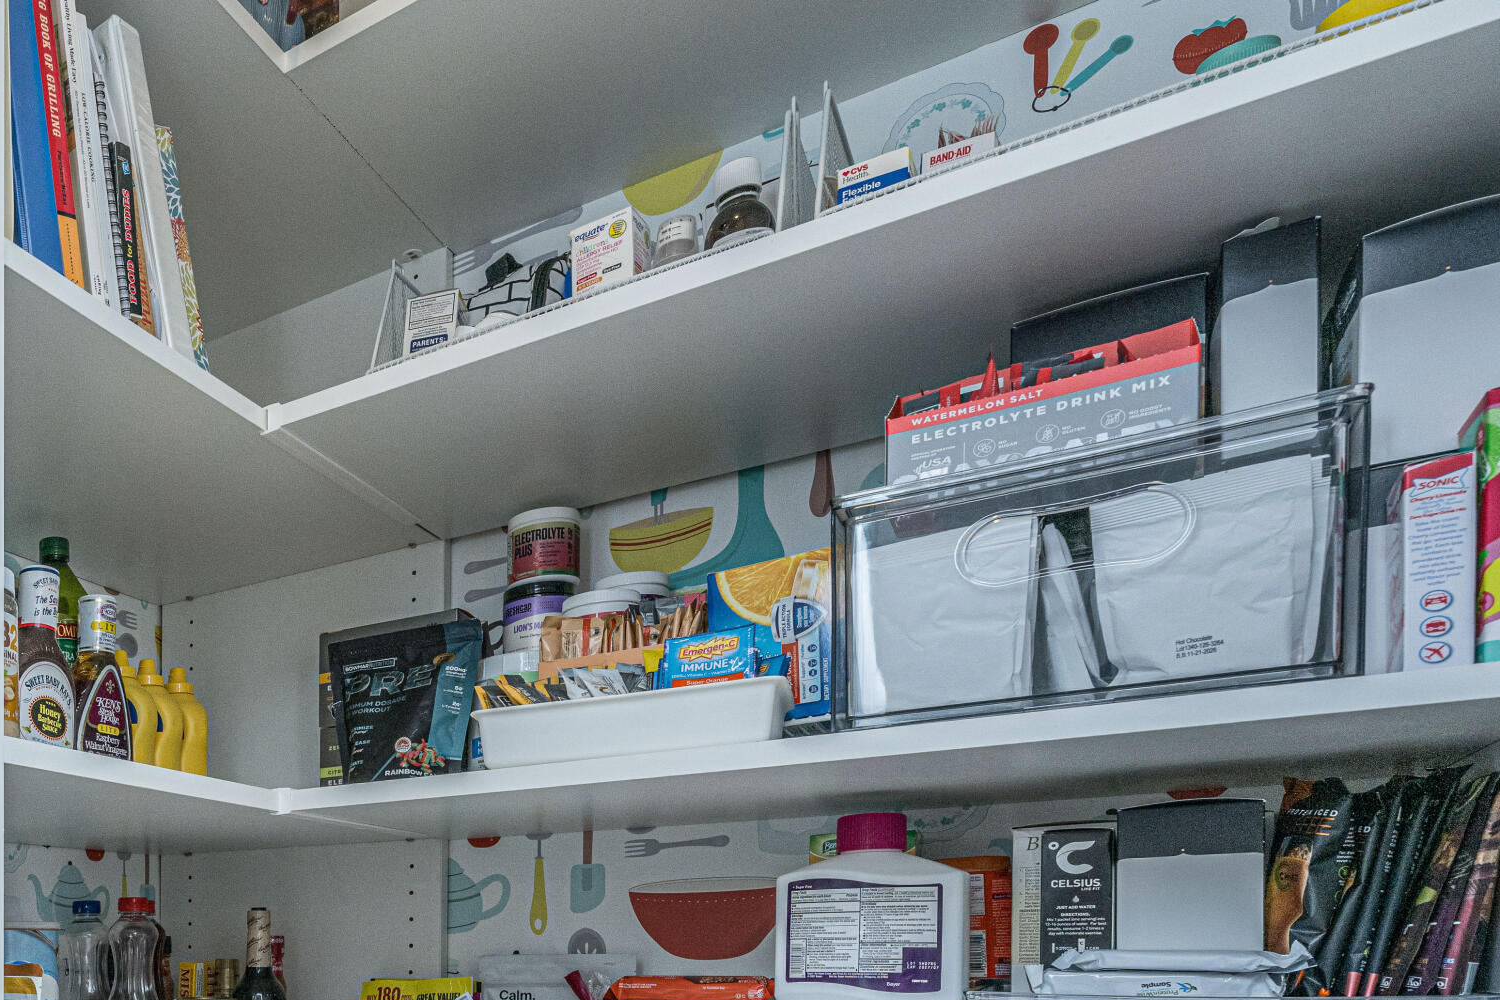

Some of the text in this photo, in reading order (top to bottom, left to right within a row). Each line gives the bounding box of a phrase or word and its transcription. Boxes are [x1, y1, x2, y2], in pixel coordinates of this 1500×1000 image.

[40, 14, 61, 138] BOOK GRILLING
[930, 145, 972, 165] BAND-AID
[850, 164, 869, 175] CVS
[842, 181, 882, 198] Flexible
[575, 224, 607, 242] equate
[122, 189, 137, 304] FOOD DUDES
[911, 389, 1043, 426] WATERMELON SALT
[911, 375, 1172, 445] ELECTROLYTE DRINK MIX
[1417, 476, 1460, 490] SONIC
[514, 527, 565, 547] ELECTROLYTE
[515, 543, 533, 559] PLUS
[682, 638, 737, 658] Emergen-C
[345, 664, 436, 700] PRE
[39, 704, 61, 718] Honey
[96, 697, 122, 712] KEN'S
[38, 714, 62, 729] Barbecue
[42, 724, 58, 734] Sauce
[100, 725, 118, 735] LITE
[1314, 808, 1338, 817] ICED
[1051, 879, 1101, 888] CELSIUS
[499, 989, 535, 1000] Calm.
